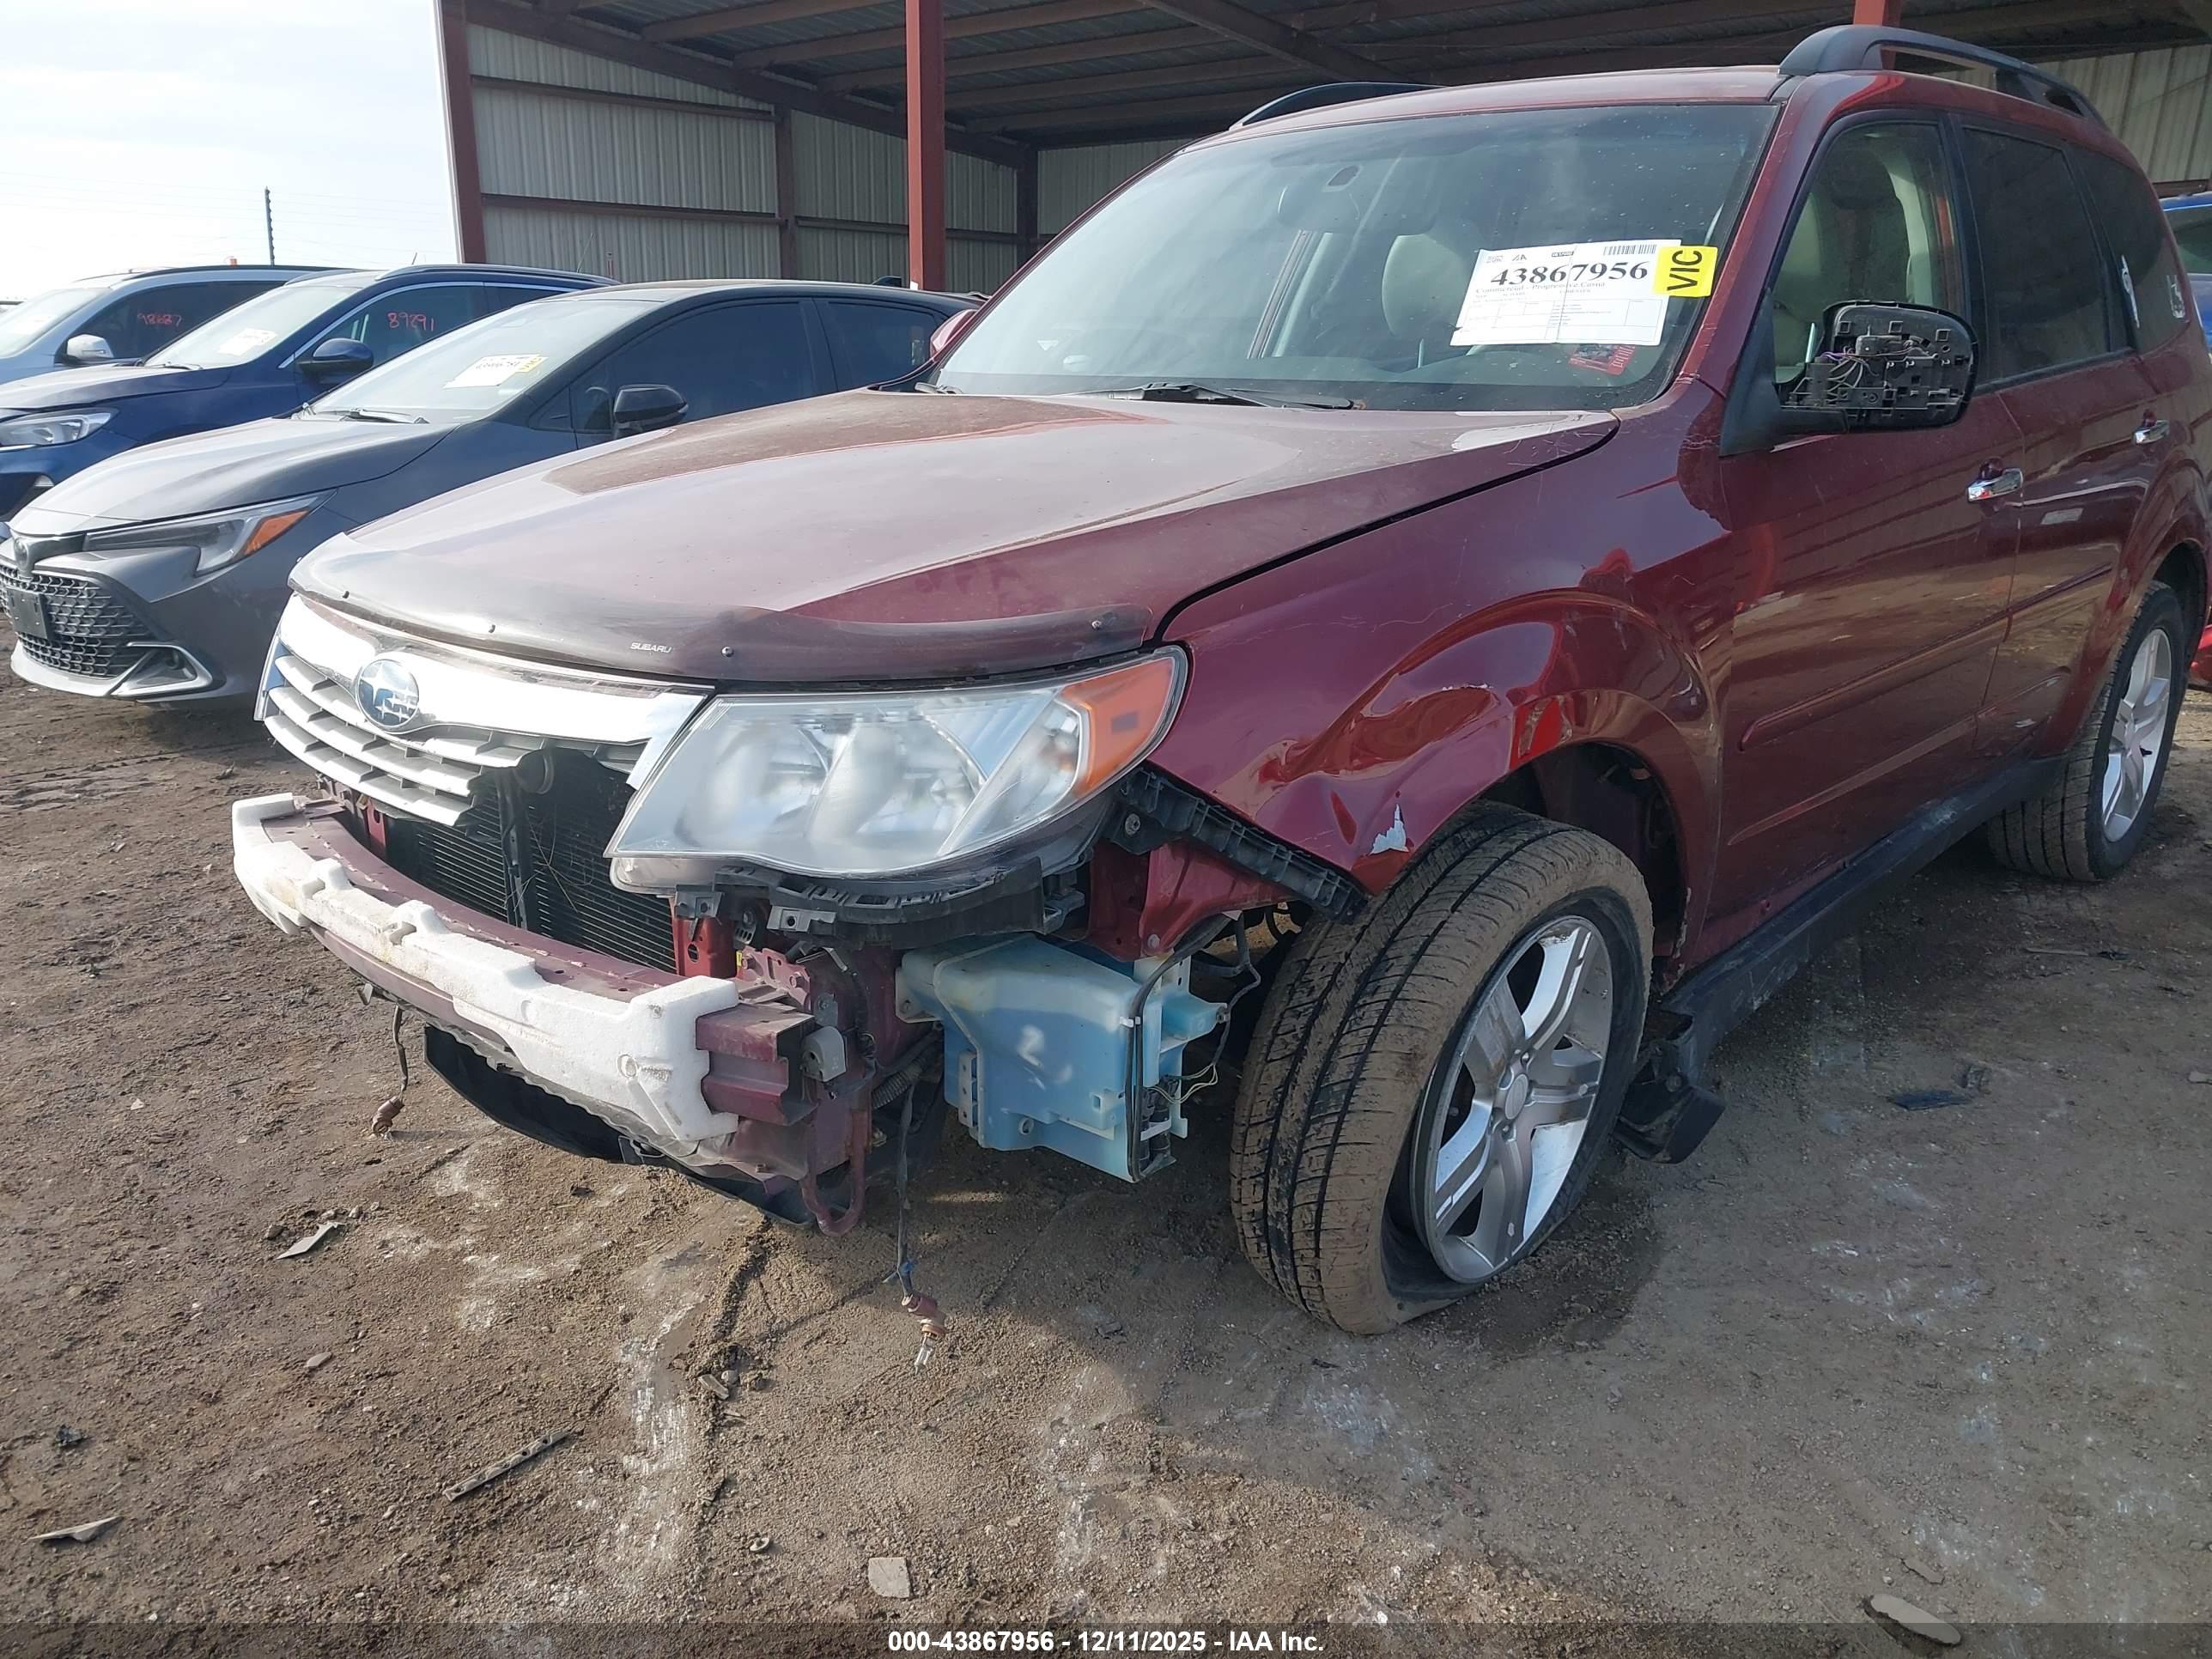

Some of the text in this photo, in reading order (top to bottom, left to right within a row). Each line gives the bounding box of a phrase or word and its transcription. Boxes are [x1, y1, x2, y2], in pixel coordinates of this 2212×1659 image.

[1491, 261, 1650, 286] 43867956
[1667, 250, 1703, 291] VIC
[629, 642, 672, 653] SUBARU
